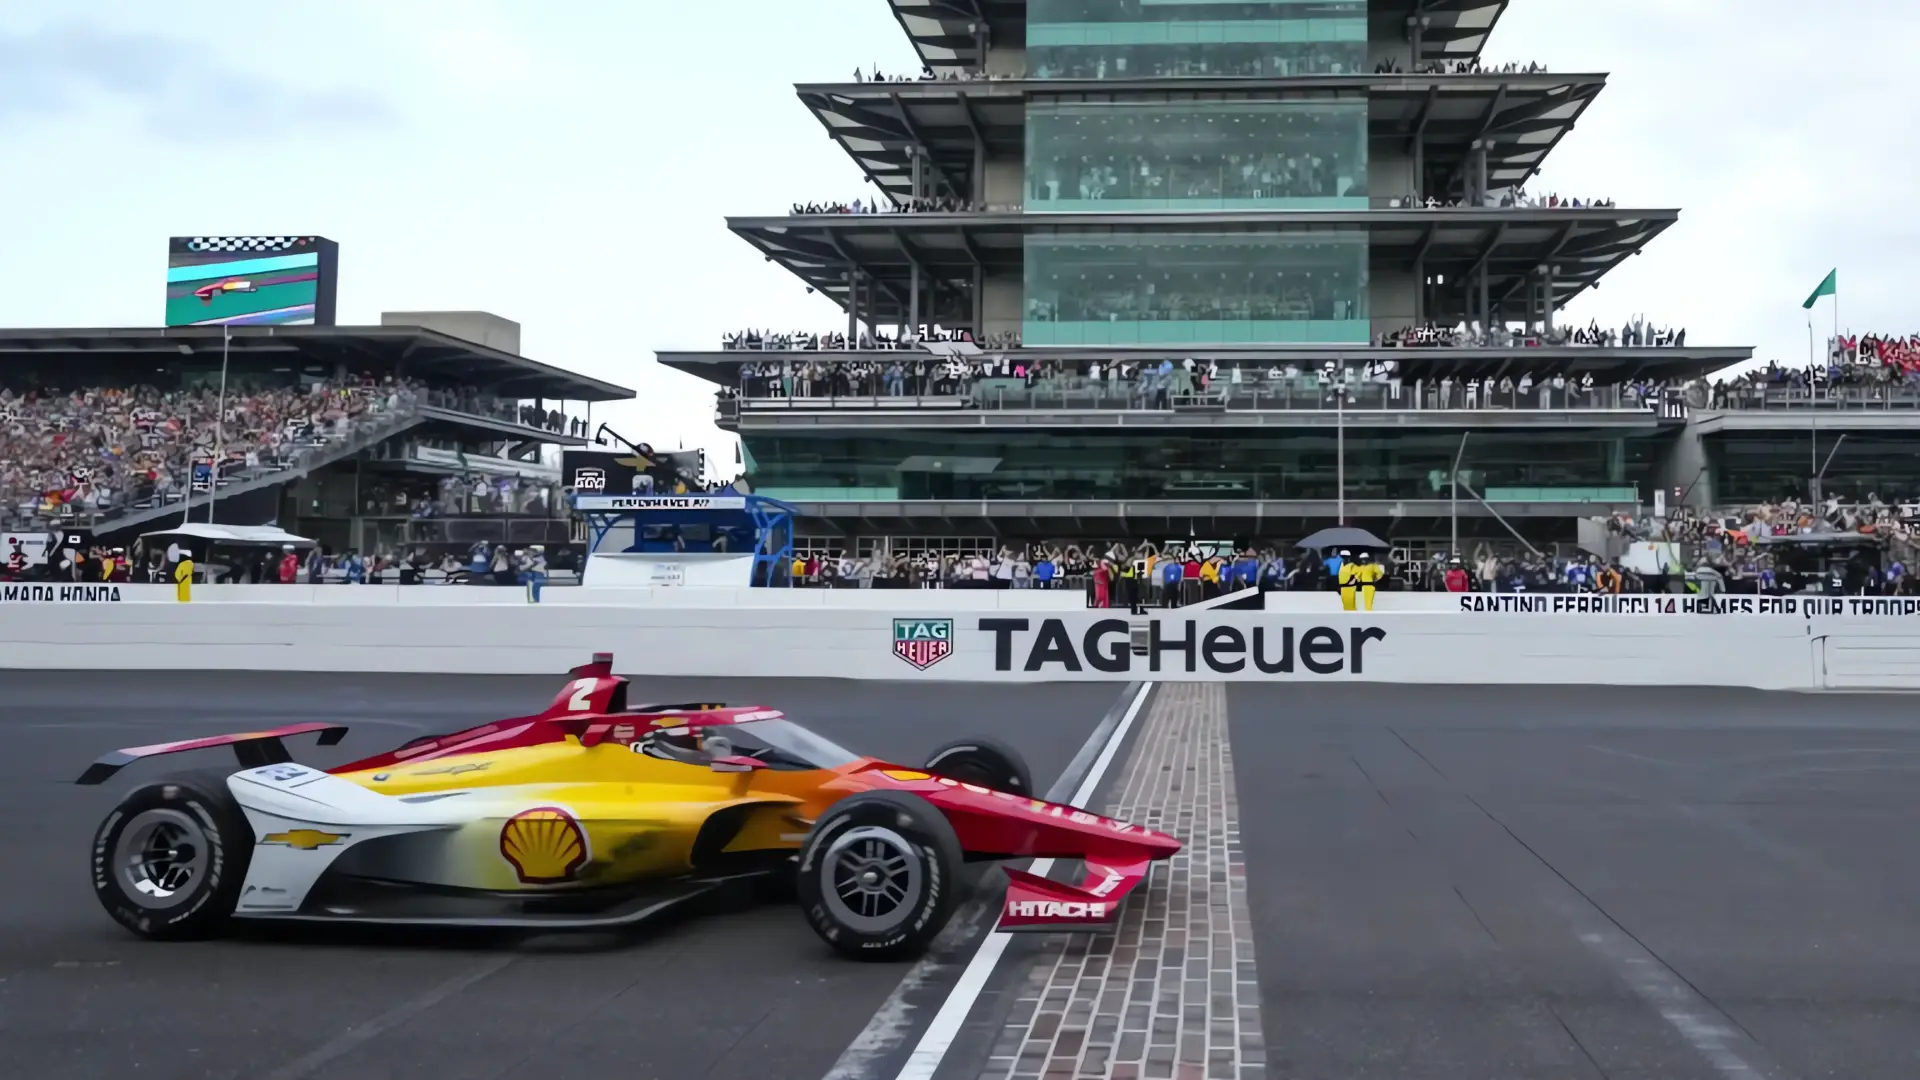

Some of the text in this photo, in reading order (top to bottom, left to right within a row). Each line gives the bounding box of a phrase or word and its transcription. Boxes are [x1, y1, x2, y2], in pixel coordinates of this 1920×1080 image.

[0, 586, 121, 602] MADA HONDA
[1460, 596, 1547, 612] SANTINO
[1553, 596, 1649, 613] FERRUCCI
[1655, 598, 1677, 613] 14
[1682, 598, 1753, 615] HOMES
[1759, 598, 1797, 614] FOR
[1803, 599, 1844, 616] OUR
[899, 623, 947, 639] TAG
[897, 641, 947, 665] HEUER
[979, 618, 1387, 674] TAG Heuer
[568, 677, 598, 711] 2
[1008, 901, 1106, 918] HITACHI
